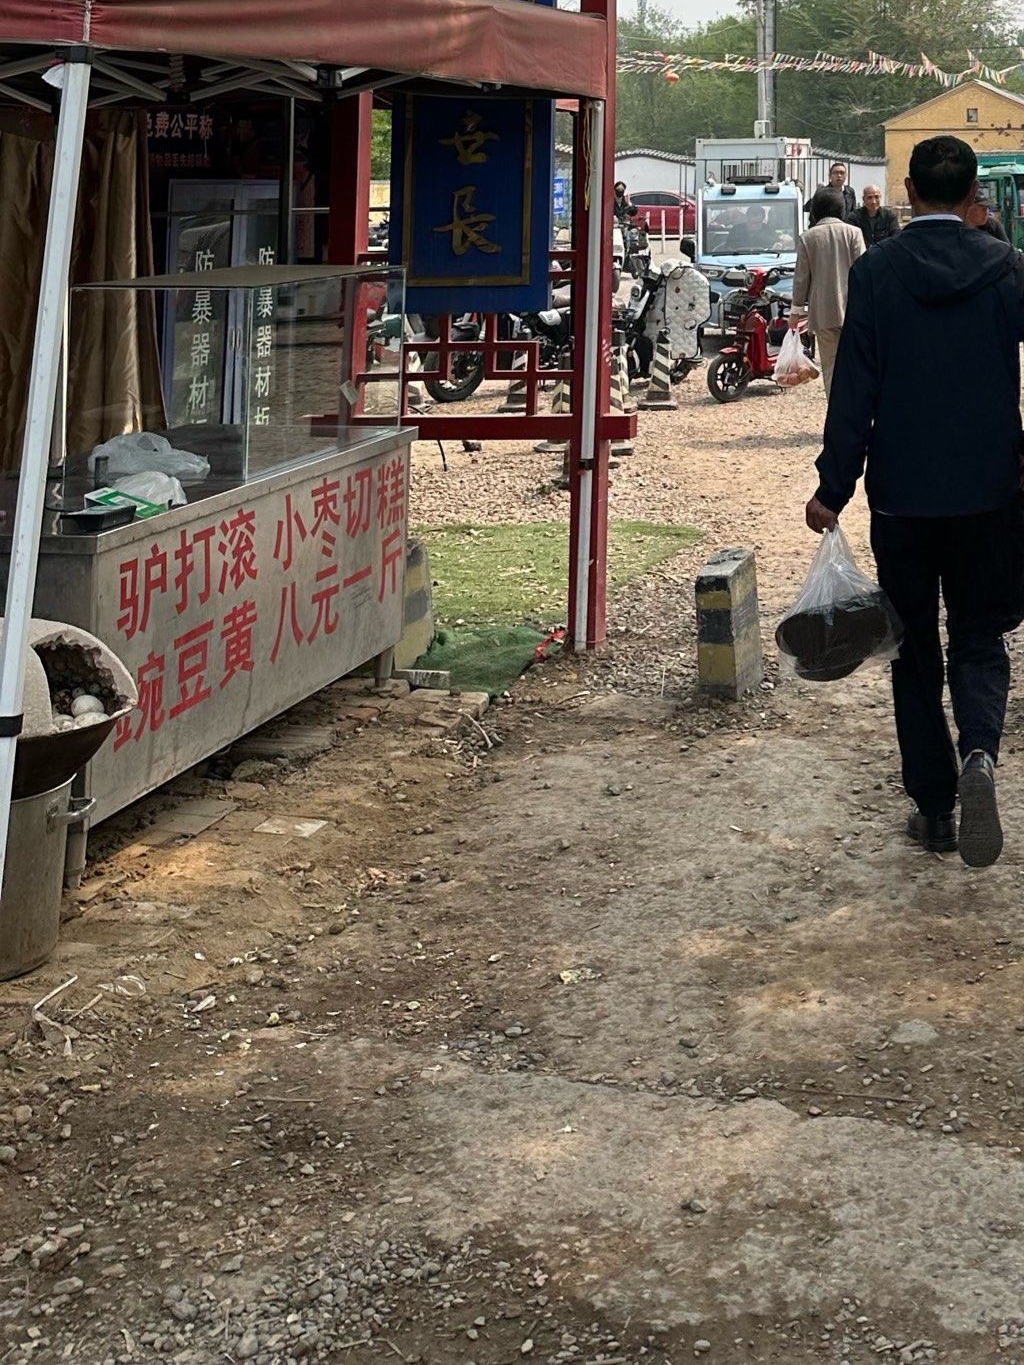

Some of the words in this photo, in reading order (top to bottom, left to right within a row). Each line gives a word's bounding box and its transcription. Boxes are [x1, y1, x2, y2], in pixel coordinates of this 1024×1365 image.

[116, 507, 259, 641] 驴打滚
[273, 457, 406, 572] 小枣切糕
[270, 529, 404, 665] 八元一斤
